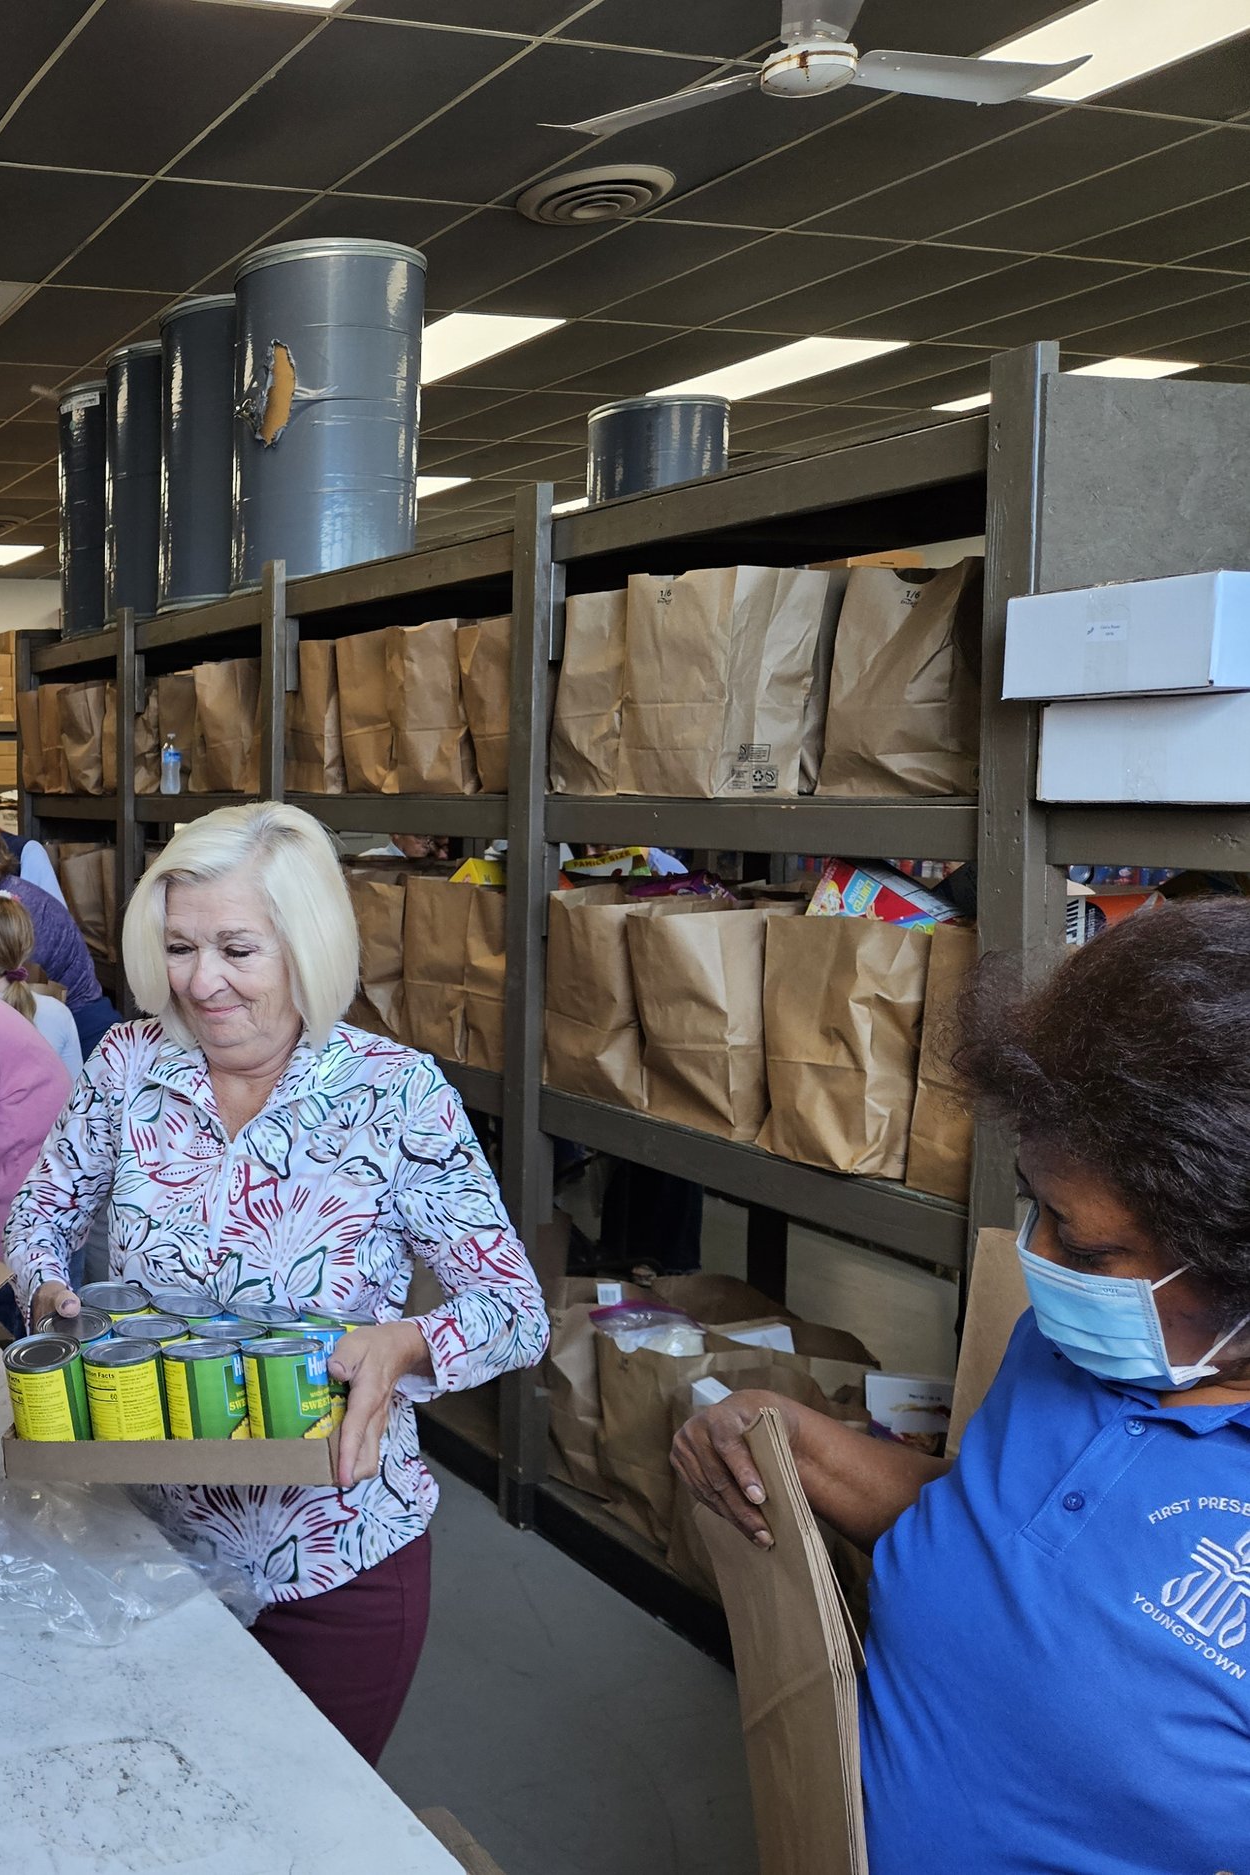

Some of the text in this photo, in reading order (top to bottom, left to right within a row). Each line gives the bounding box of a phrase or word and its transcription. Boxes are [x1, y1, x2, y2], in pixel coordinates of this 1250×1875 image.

[573, 850, 631, 868] FAMILY SIZE
[1148, 1498, 1191, 1525] FIRST
[1132, 1591, 1247, 1680] YOUNGSTOWN
